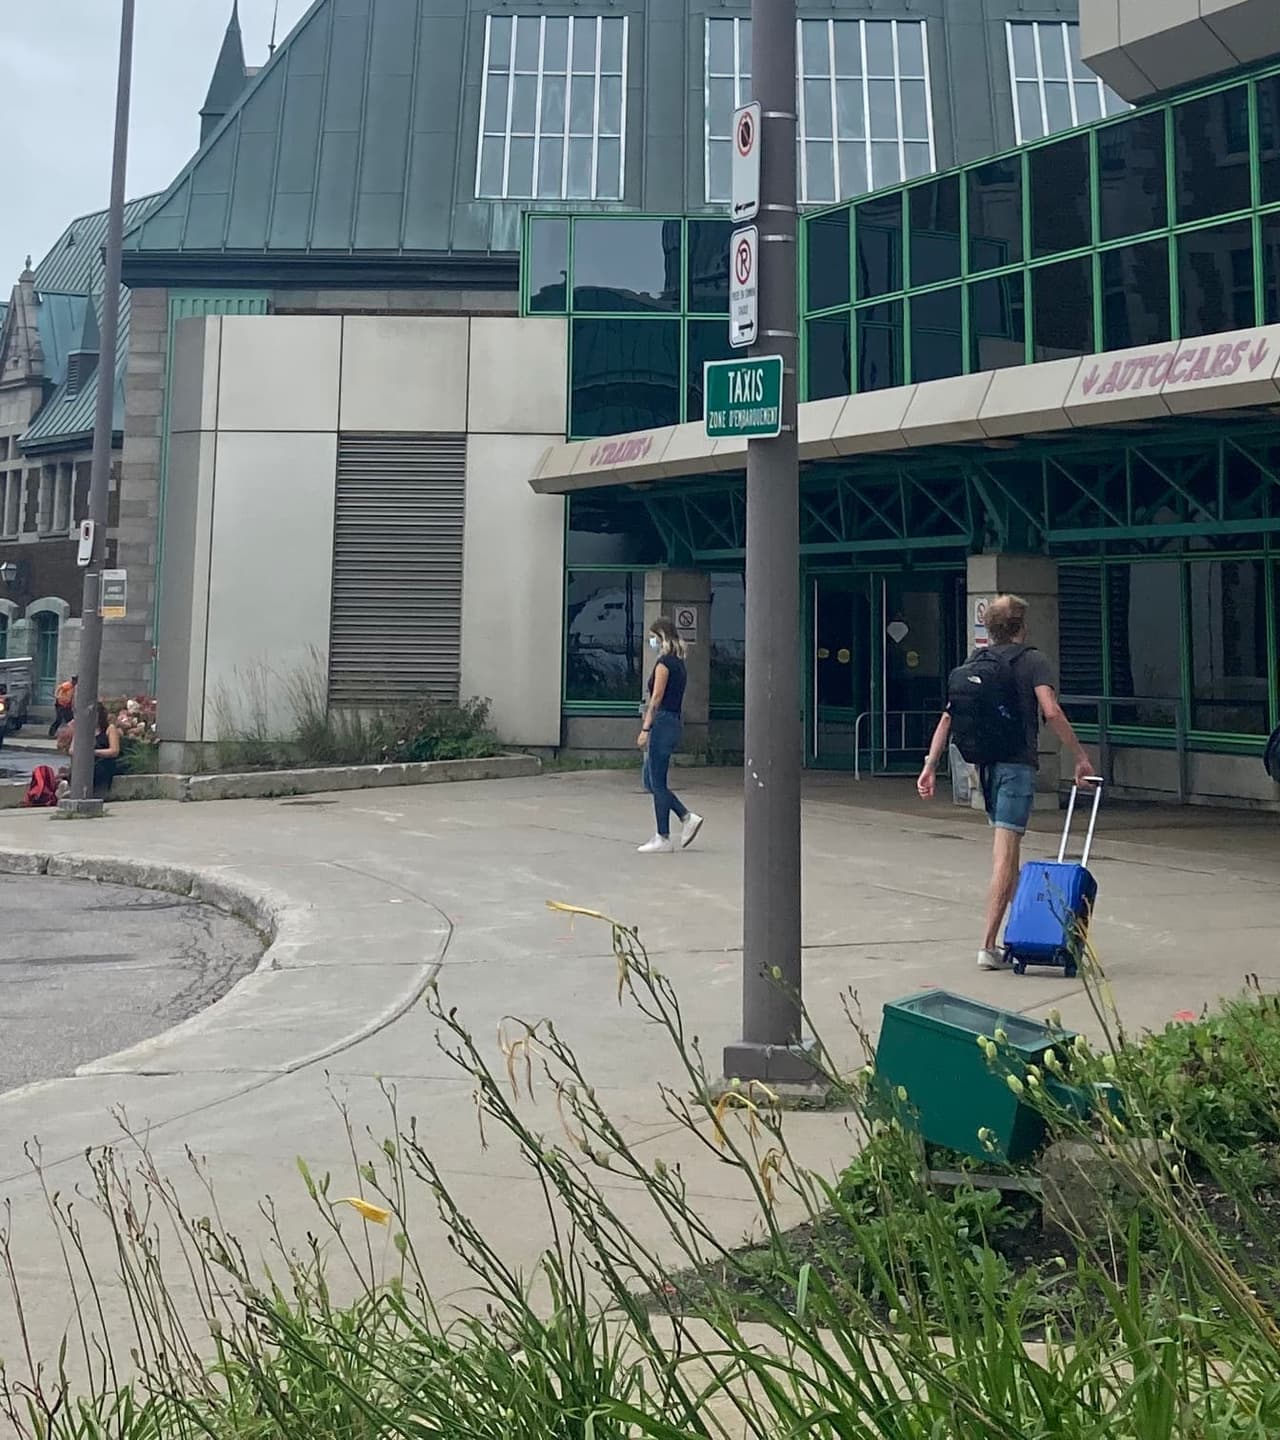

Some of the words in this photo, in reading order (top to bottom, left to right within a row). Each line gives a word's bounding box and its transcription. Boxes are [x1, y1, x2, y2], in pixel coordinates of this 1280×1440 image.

[1095, 339, 1251, 395] AUTOCARS
[728, 368, 764, 404] TAXIS
[708, 410, 726, 429] ZONE
[728, 406, 778, 428] D'EMBARQUEMENT
